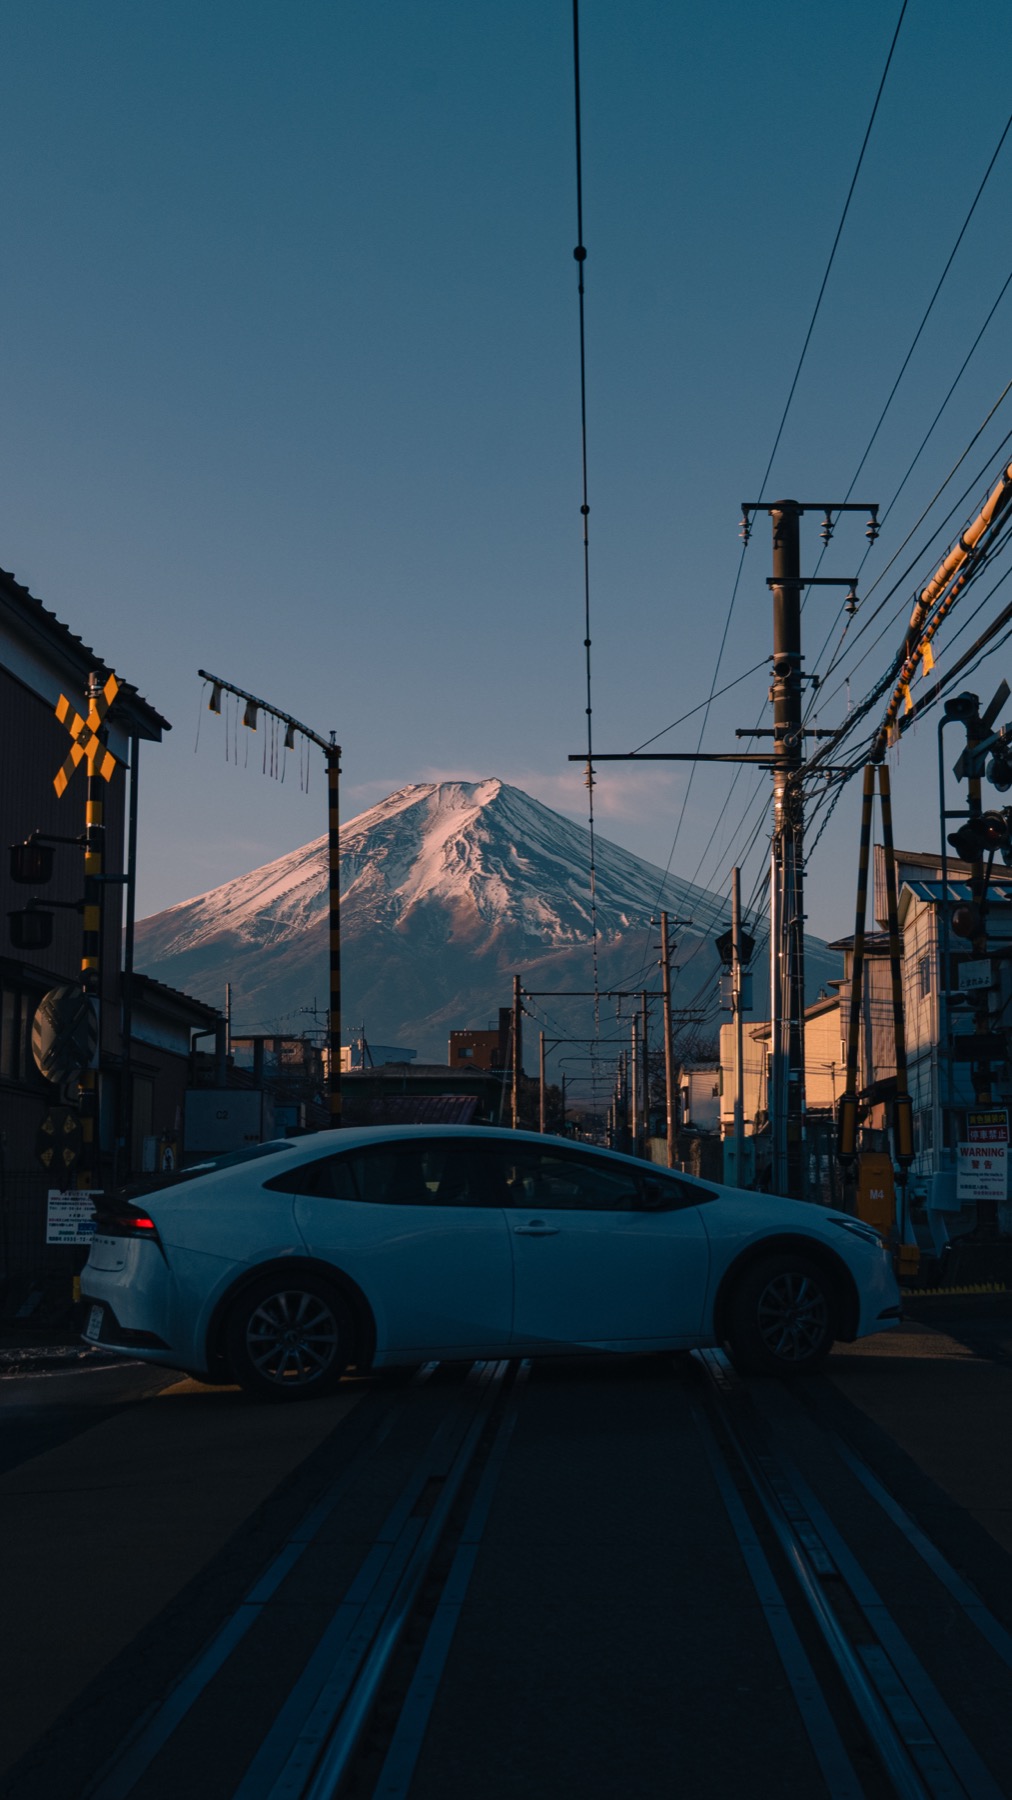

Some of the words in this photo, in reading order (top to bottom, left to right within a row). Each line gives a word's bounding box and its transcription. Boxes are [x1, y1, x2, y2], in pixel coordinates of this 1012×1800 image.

[960, 977, 989, 987] とまれみよ
[216, 1110, 229, 1120] C2
[970, 1128, 1007, 1140] 停車禁止
[960, 1147, 1004, 1157] WARNING
[869, 1189, 885, 1200] M4
